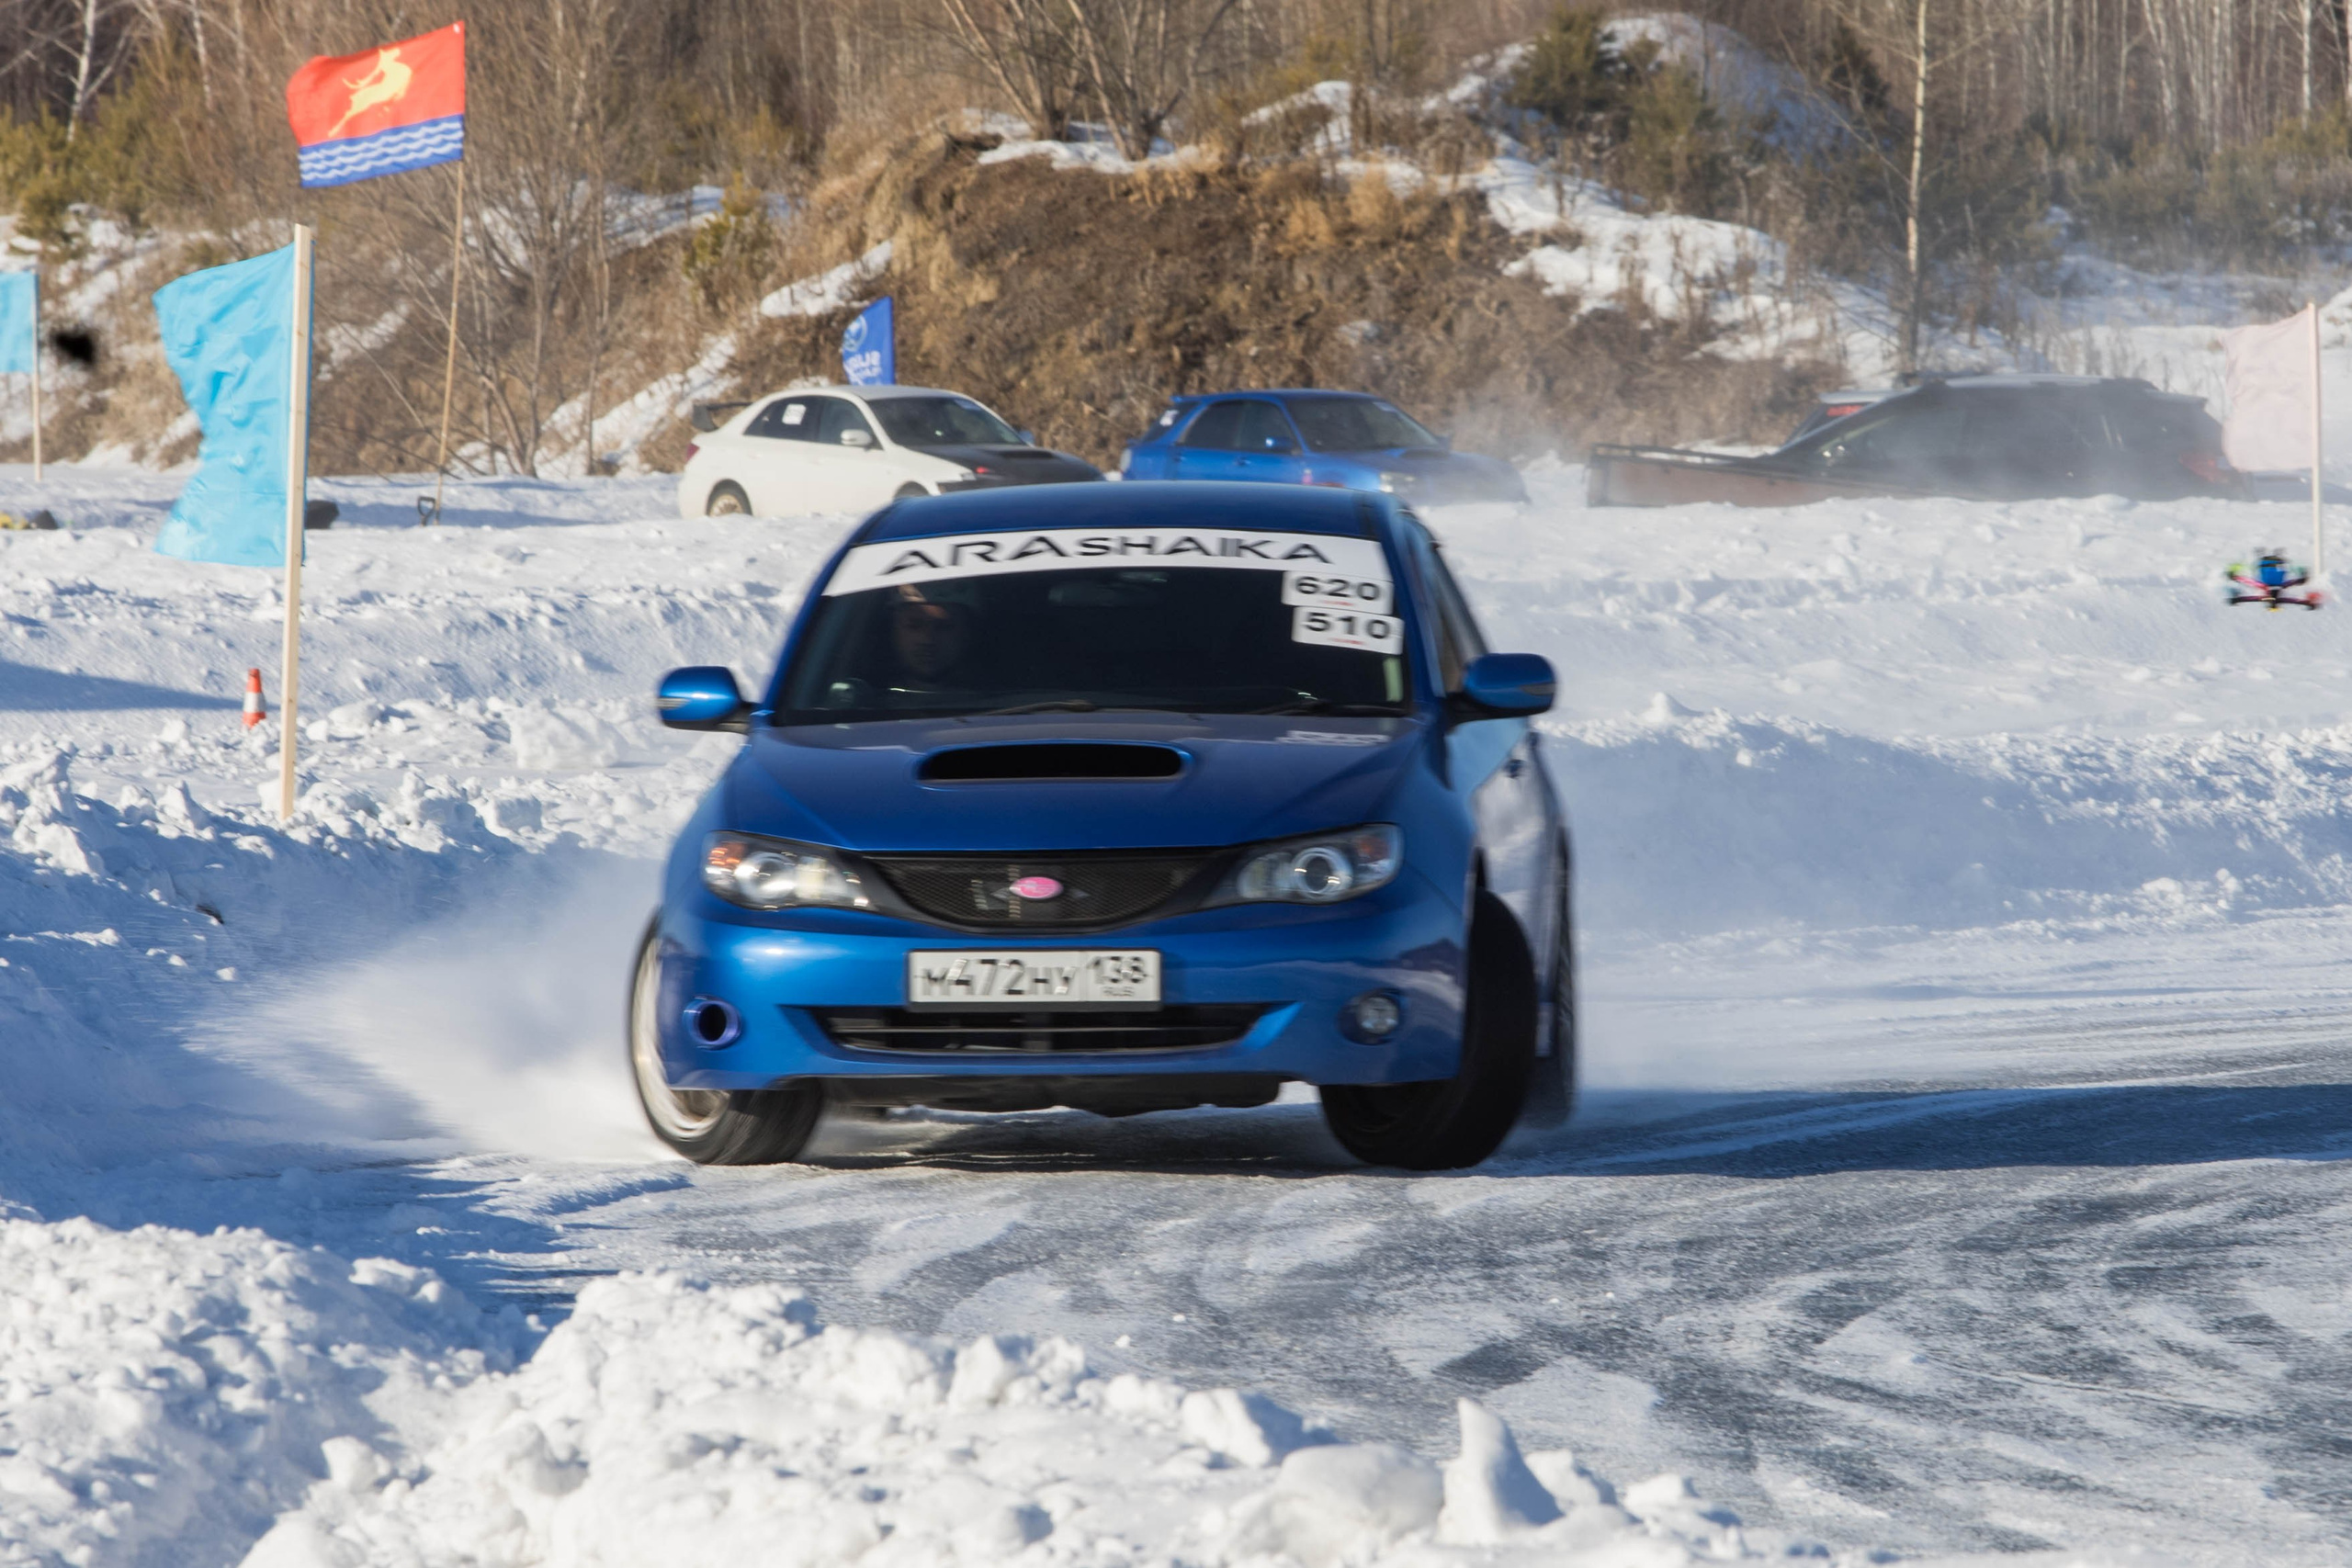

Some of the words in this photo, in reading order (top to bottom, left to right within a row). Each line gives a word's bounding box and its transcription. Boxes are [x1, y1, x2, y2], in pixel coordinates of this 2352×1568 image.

[879, 535, 1332, 576] ARASHAIKA
[1295, 576, 1380, 601] 620
[1305, 612, 1391, 639] 510
